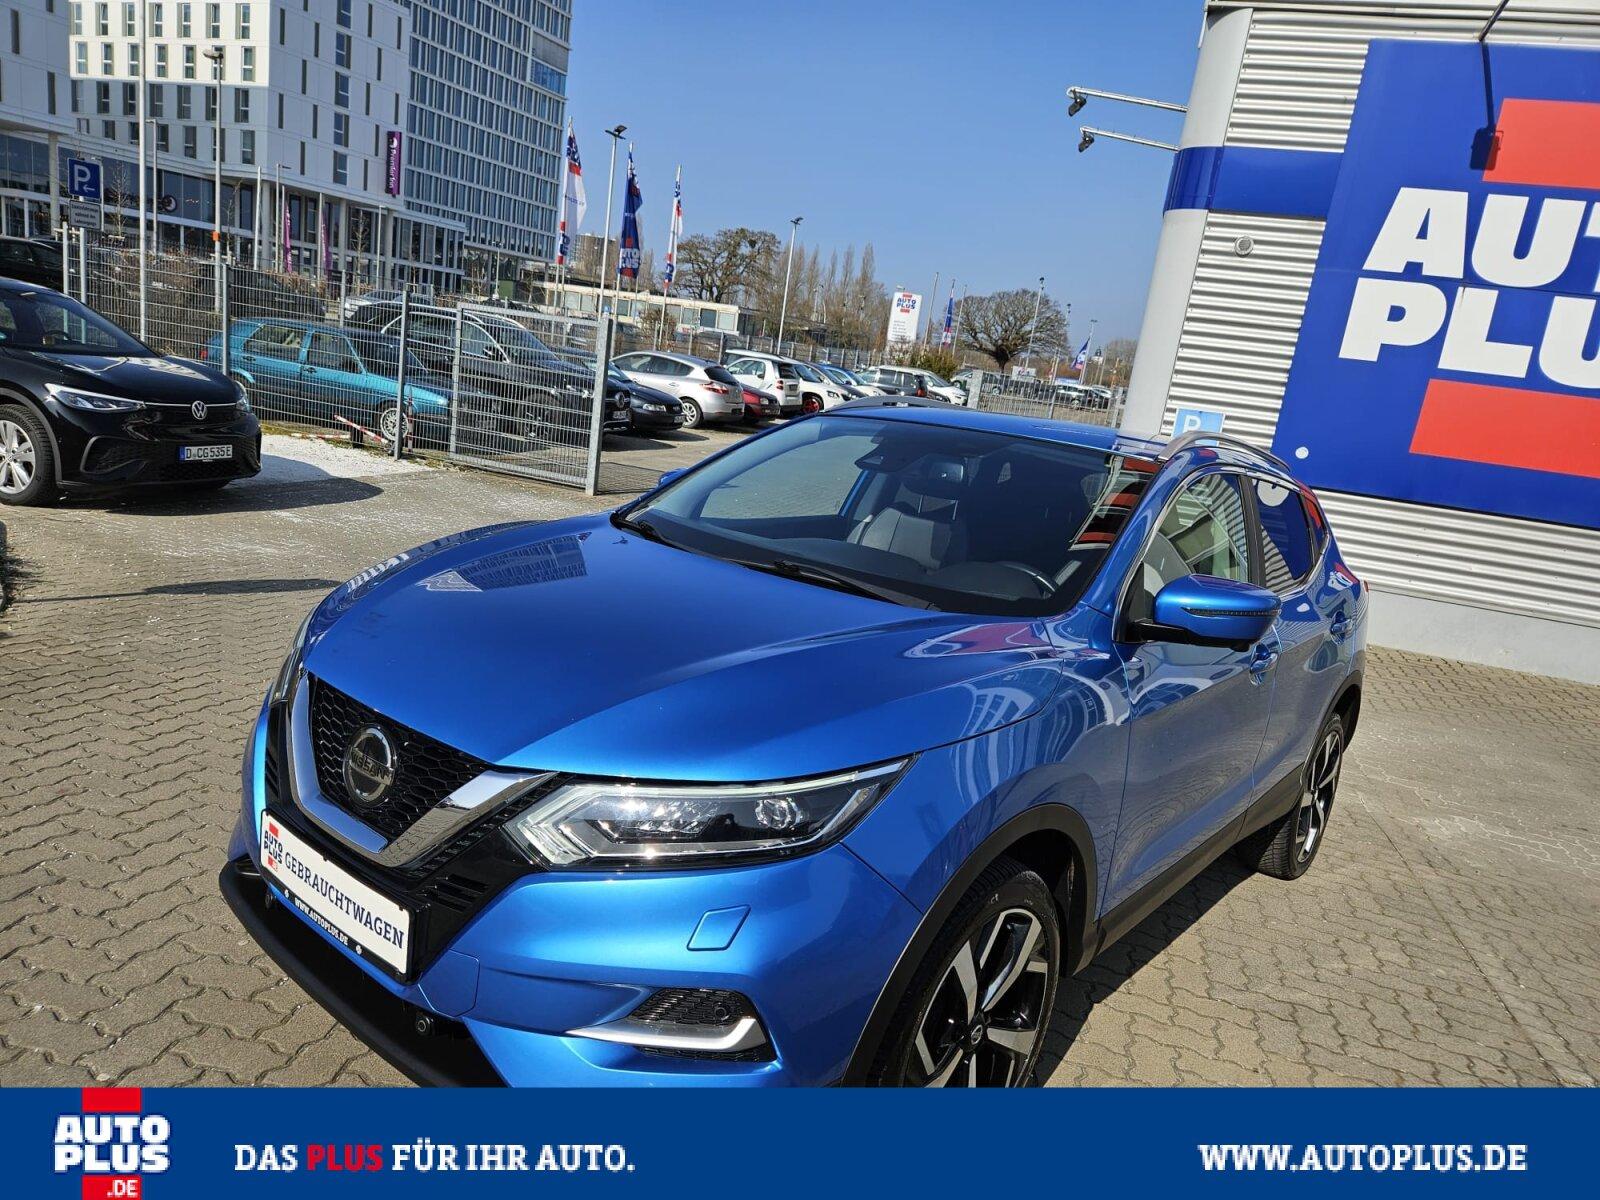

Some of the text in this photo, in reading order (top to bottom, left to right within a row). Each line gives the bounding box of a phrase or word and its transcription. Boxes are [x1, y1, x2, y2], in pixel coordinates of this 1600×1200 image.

[74, 164, 91, 191] P
[1362, 187, 1600, 293] AU
[896, 302, 916, 310] PLUS
[263, 840, 283, 865] PLUS
[264, 830, 283, 854] AUTO
[285, 851, 404, 949] GEBRAUCHTWAGEN
[294, 897, 349, 946] WWW.AUTOPLUS.DE
